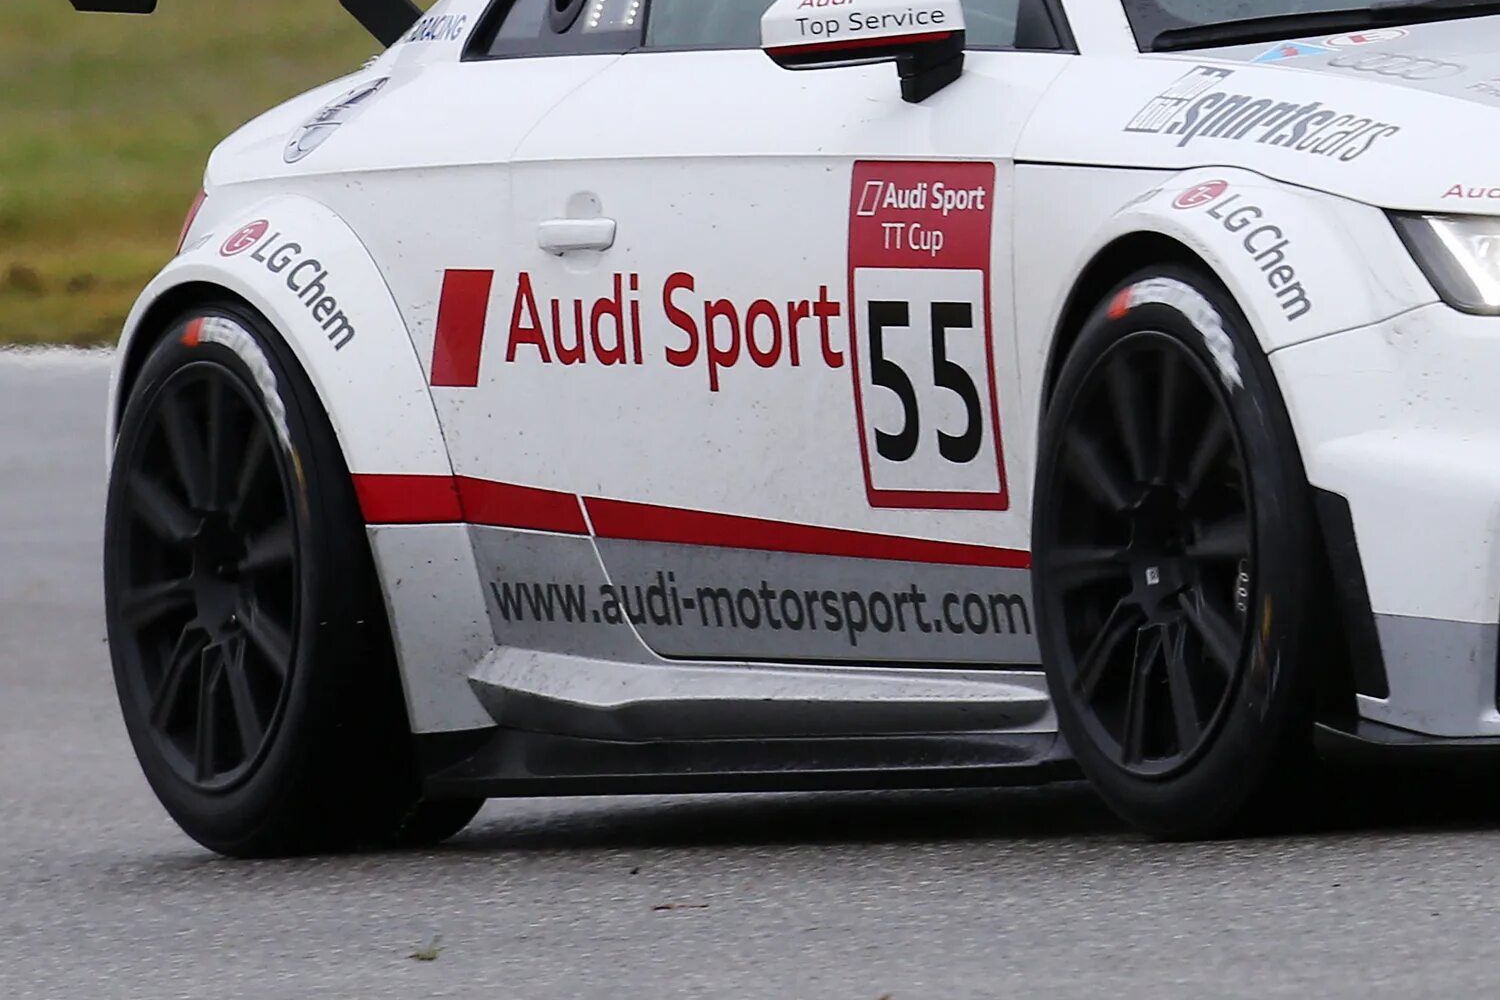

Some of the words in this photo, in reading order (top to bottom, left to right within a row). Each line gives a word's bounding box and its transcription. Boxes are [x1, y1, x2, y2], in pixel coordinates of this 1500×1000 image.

[795, 17, 840, 37] Top
[849, 8, 945, 31] Service
[882, 182, 927, 209] Audi
[931, 182, 985, 216] Sport
[881, 222, 905, 249] TT
[908, 222, 944, 257] Cup
[505, 271, 643, 365] Audi
[662, 271, 845, 392] Sport
[868, 300, 983, 464] 55
[491, 571, 1031, 647] www.audi-motorsport.com
